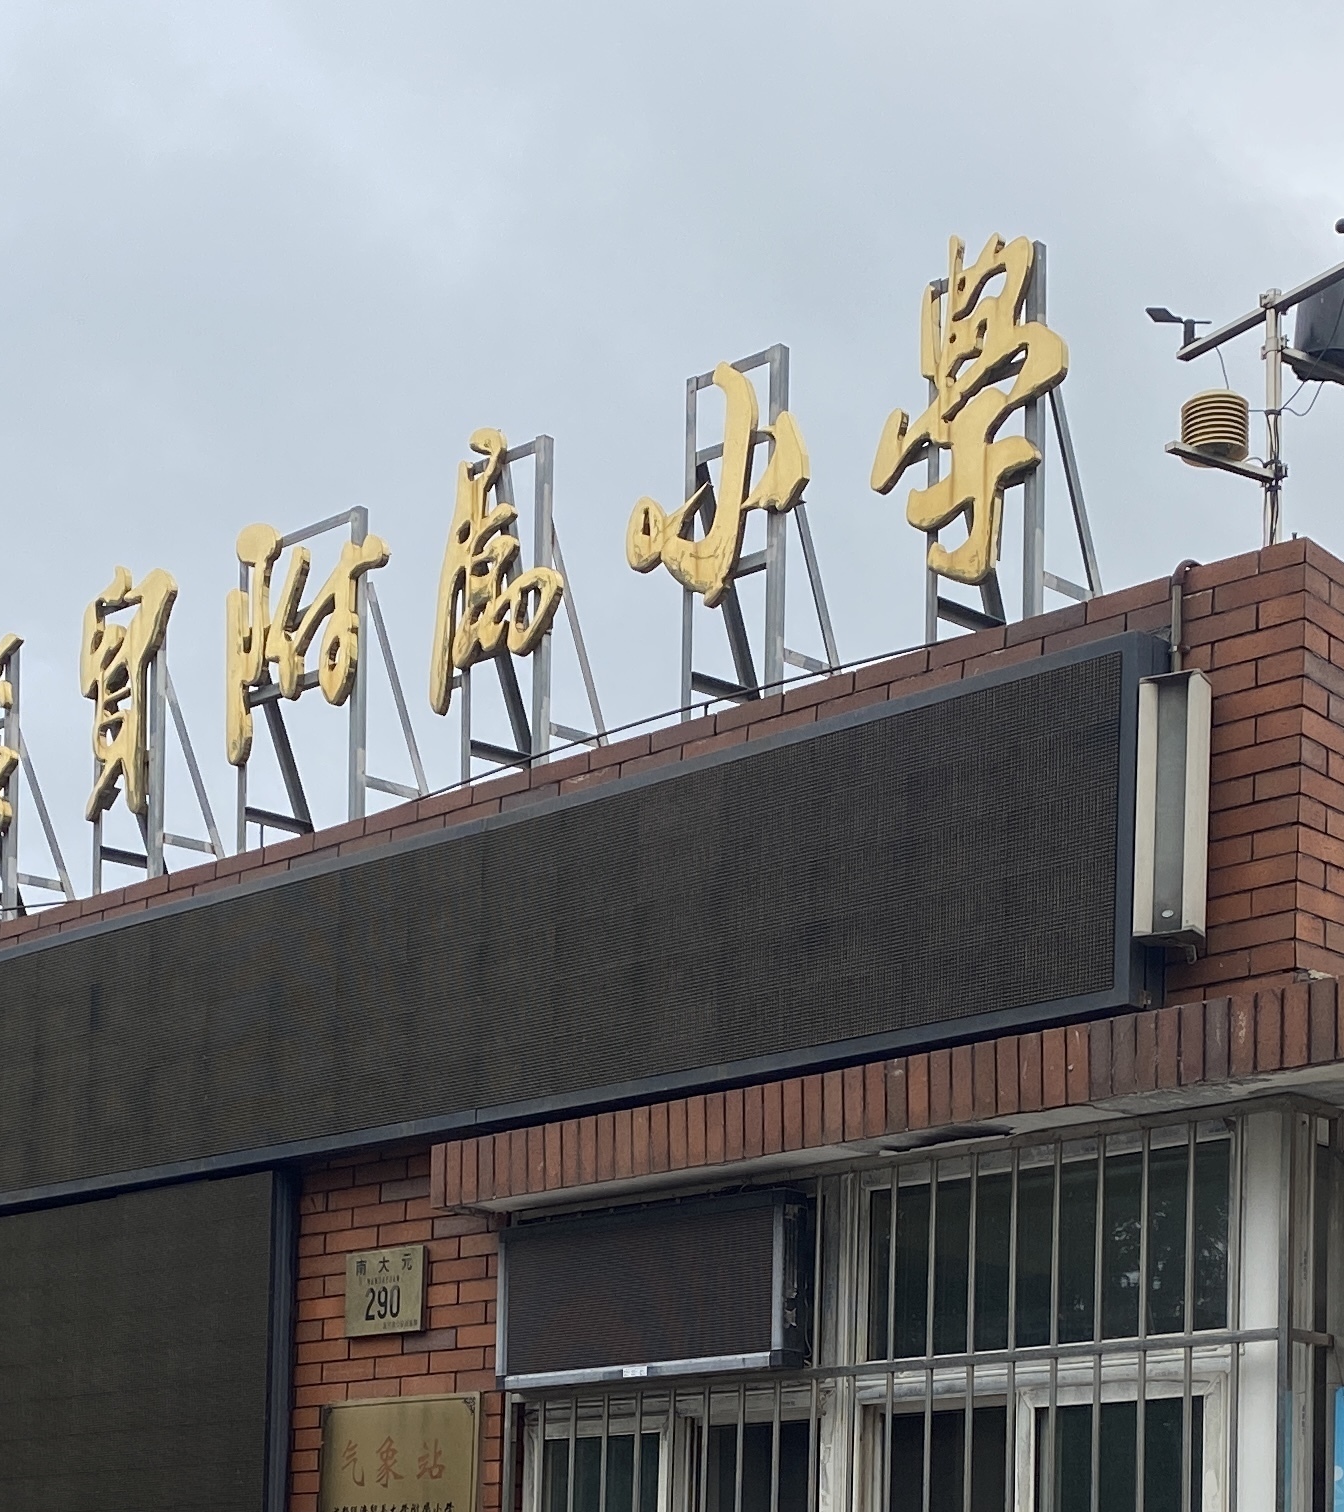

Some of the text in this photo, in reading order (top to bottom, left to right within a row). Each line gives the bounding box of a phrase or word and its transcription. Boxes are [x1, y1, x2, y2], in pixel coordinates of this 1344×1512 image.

[364, 1285, 401, 1321] 290
[341, 1436, 445, 1488] 气象站
